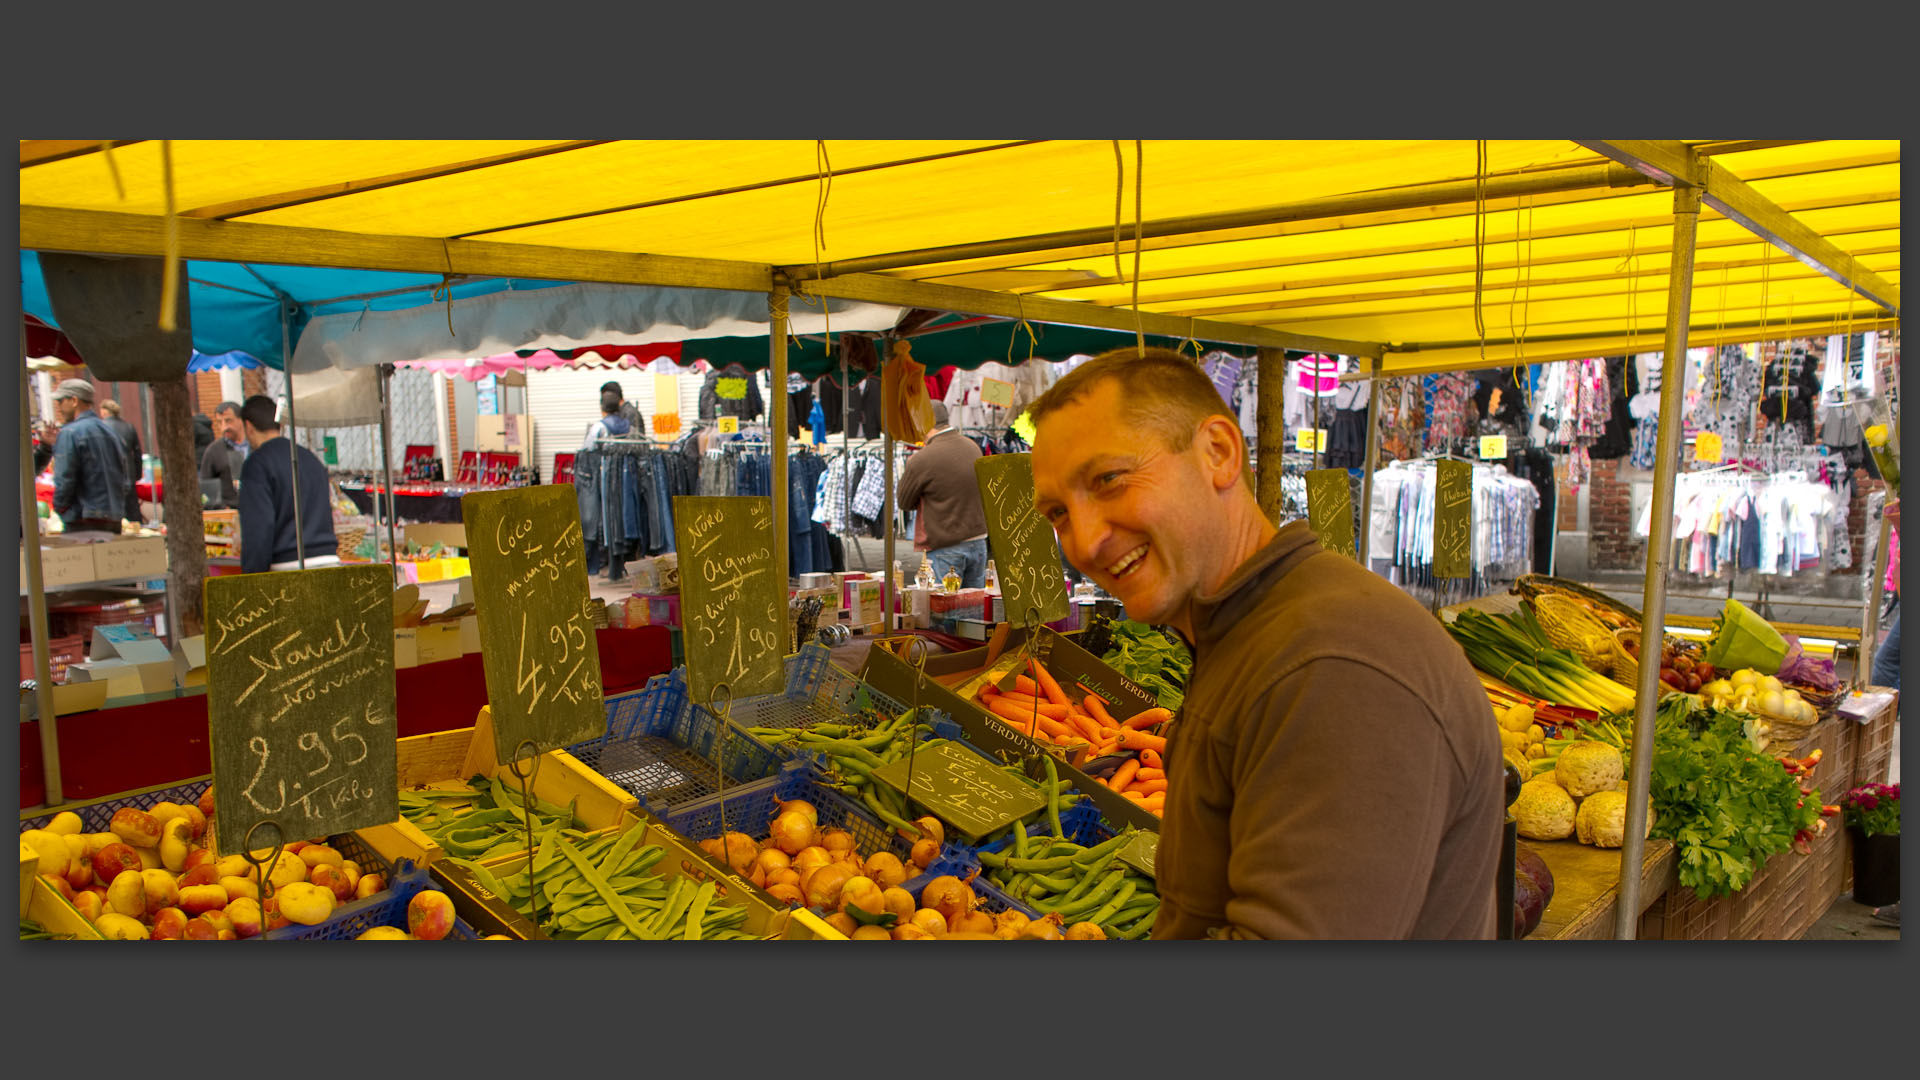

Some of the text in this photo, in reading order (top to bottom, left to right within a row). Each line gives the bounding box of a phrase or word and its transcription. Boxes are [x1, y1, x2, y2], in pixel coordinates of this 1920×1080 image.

[723, 422, 731, 432] 5
[1303, 435, 1314, 449] 5
[1487, 444, 1495, 456] 5
[496, 515, 533, 556] Coco
[703, 548, 770, 589] Oignons
[706, 589, 741, 620] livres
[1119, 676, 1160, 710] VERDUY
[983, 715, 1041, 756] VERDUYN
